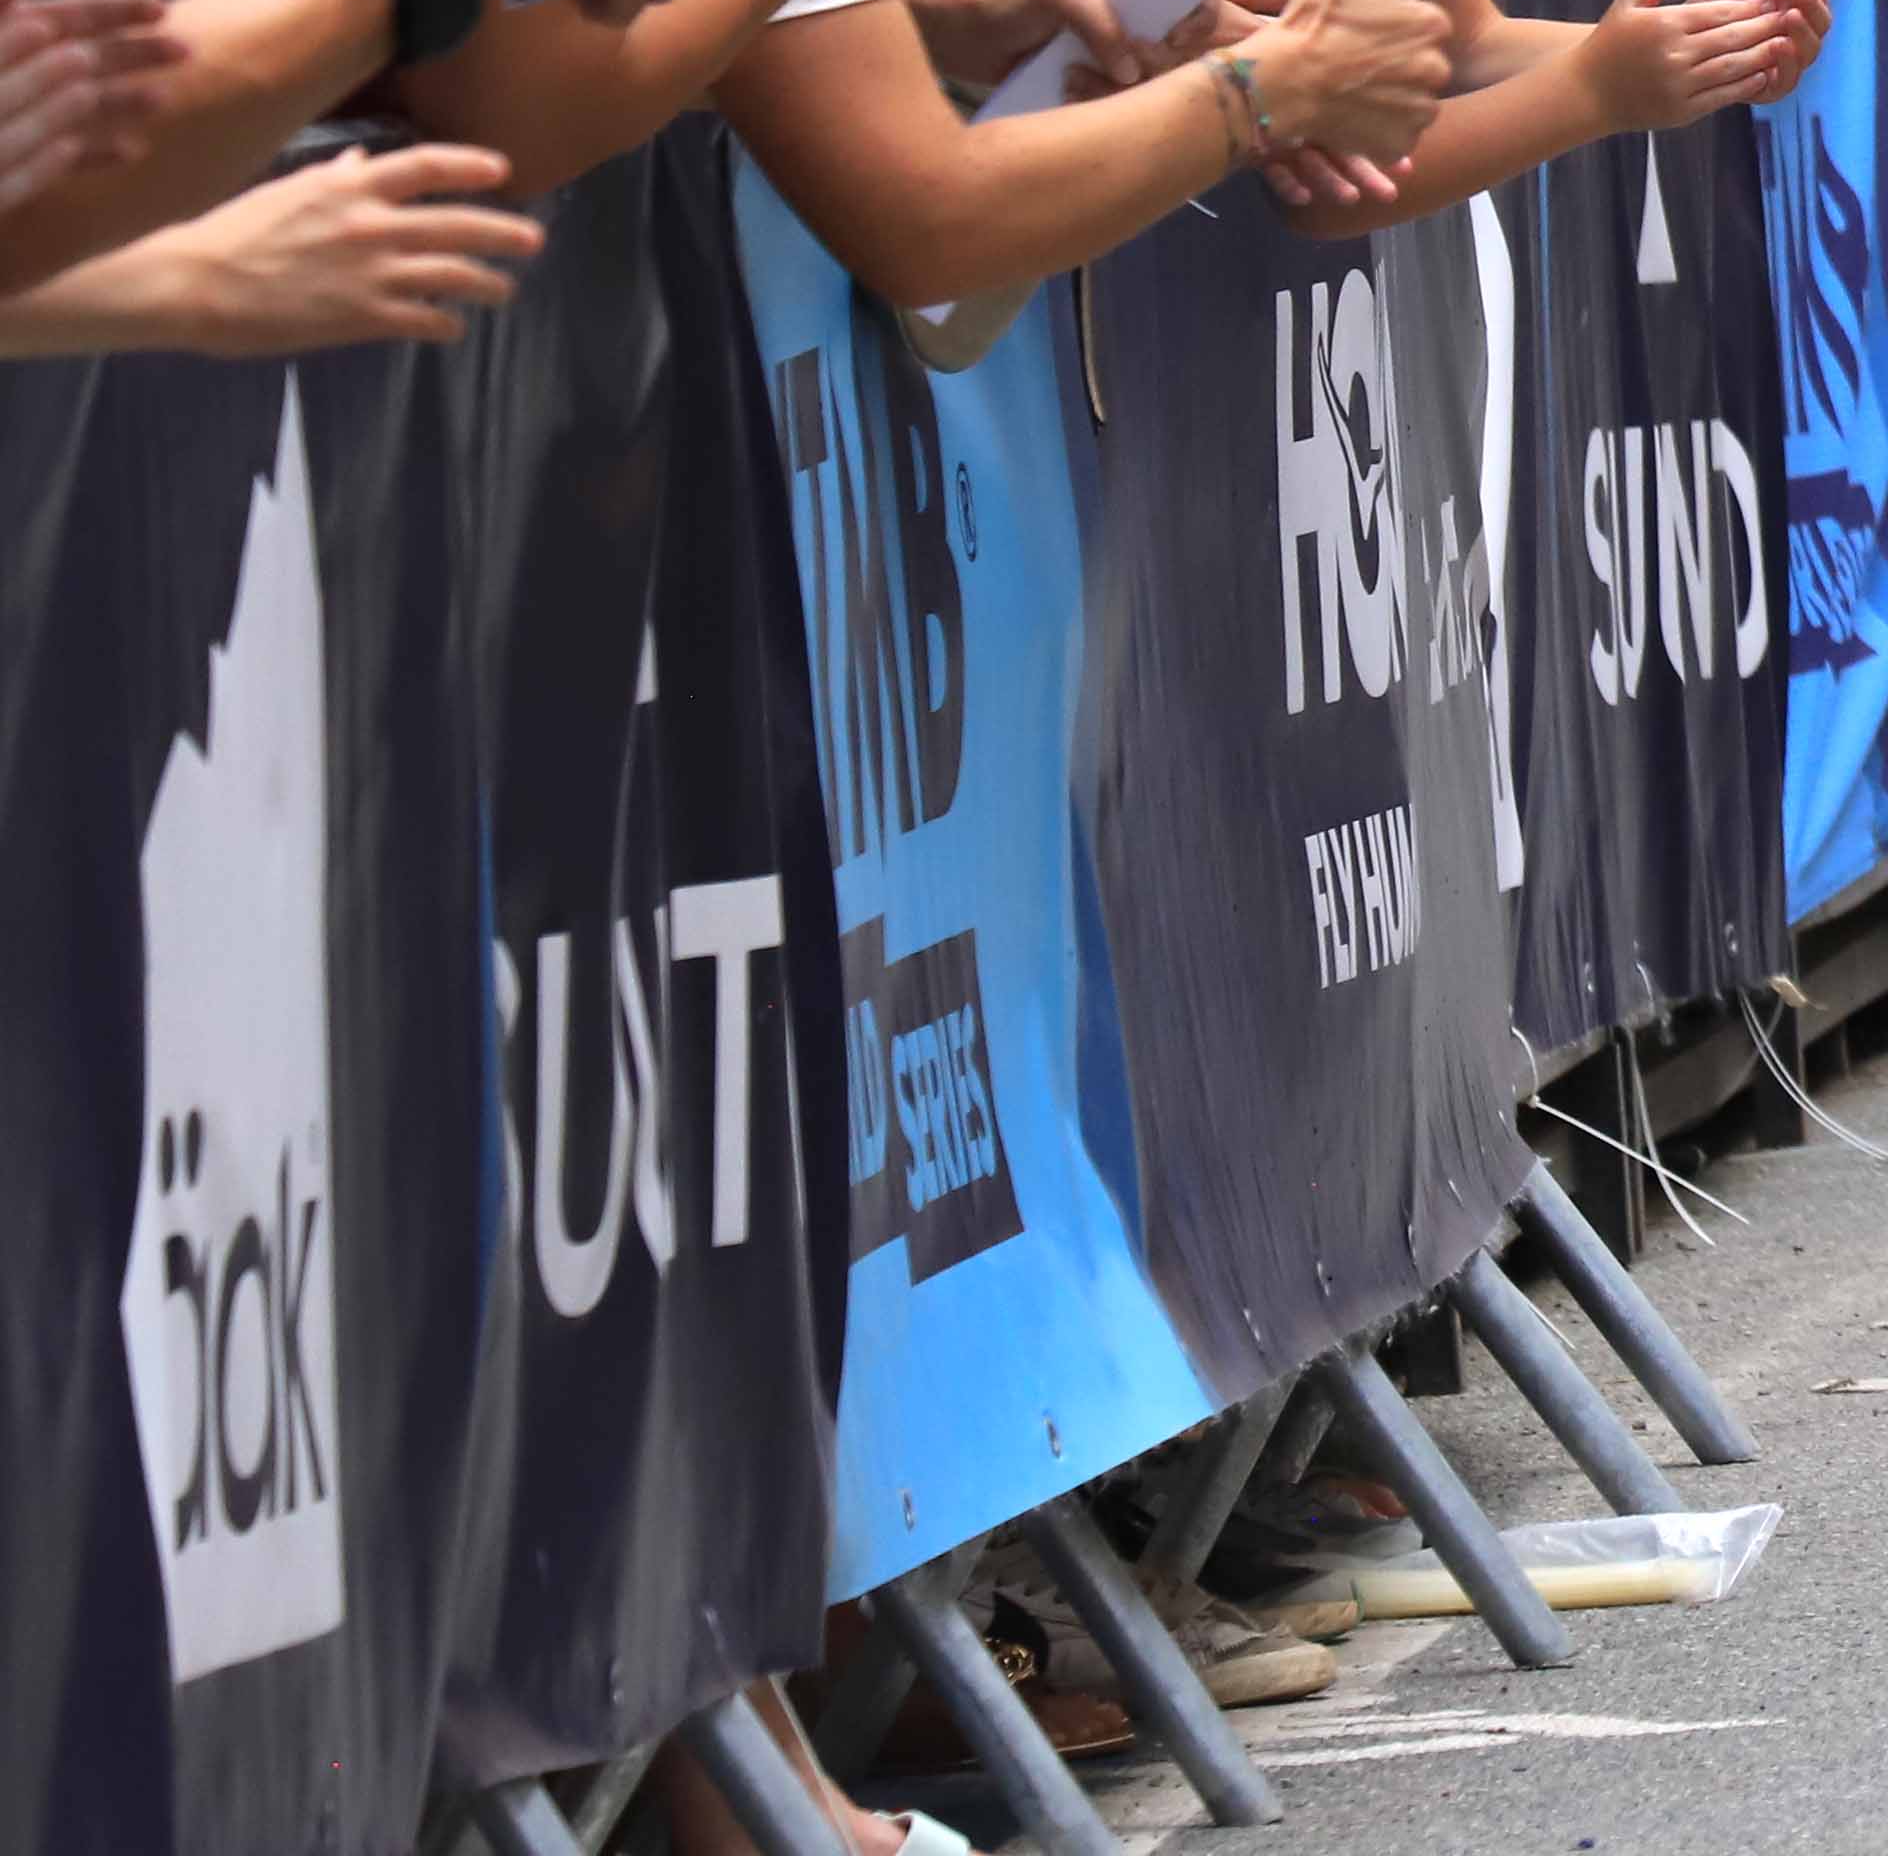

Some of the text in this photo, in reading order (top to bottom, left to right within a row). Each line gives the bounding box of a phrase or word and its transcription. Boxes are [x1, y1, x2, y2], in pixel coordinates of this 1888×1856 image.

[775, 289, 967, 874] TMB
[1303, 802, 1421, 991] FLY HUM
[890, 1001, 998, 1215] SERIES
[158, 1106, 328, 1554] äak
